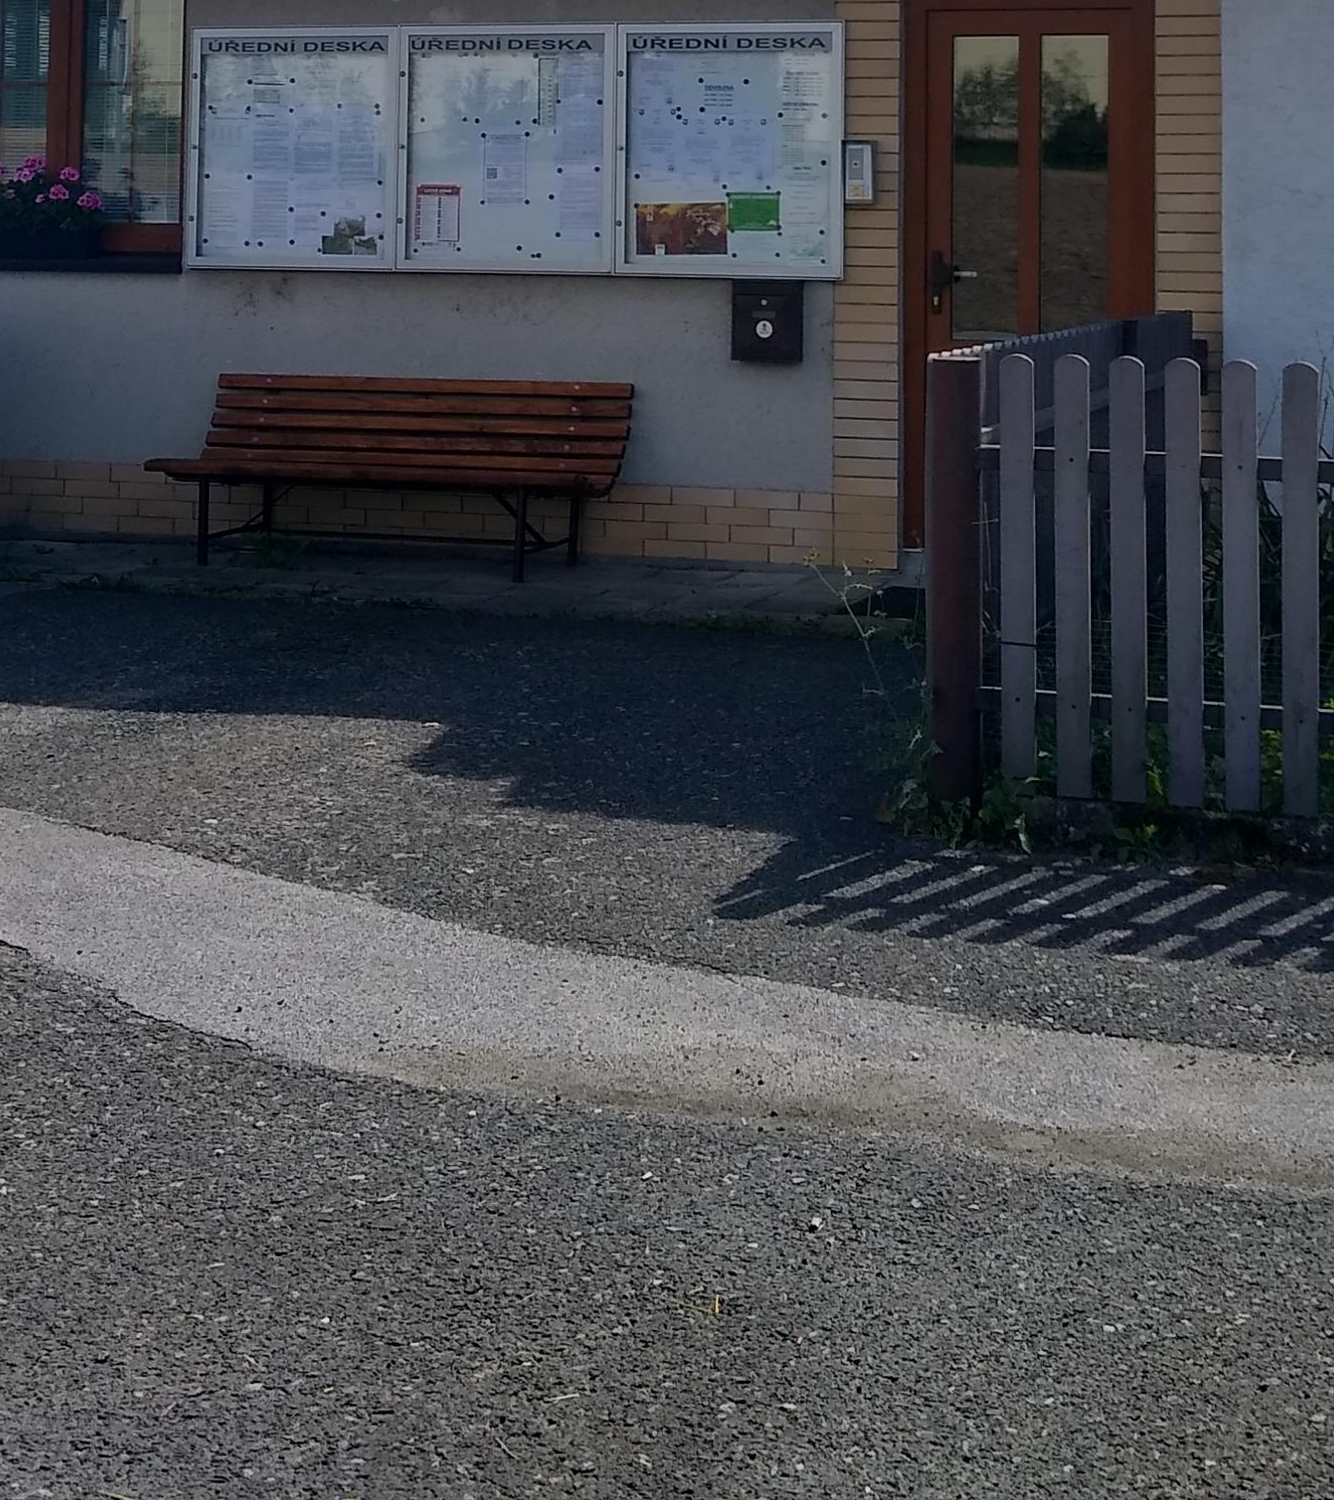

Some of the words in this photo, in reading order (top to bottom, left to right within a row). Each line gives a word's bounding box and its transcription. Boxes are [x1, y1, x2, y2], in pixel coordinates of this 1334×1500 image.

[208, 39, 296, 52] ÚŘEDNÍ
[303, 41, 385, 52] DESKA
[411, 37, 502, 50] ÚŘEDNÍ
[508, 39, 593, 50] DESKA
[632, 36, 728, 49] ÚŘEDNÍ
[736, 37, 827, 49] DESKA
